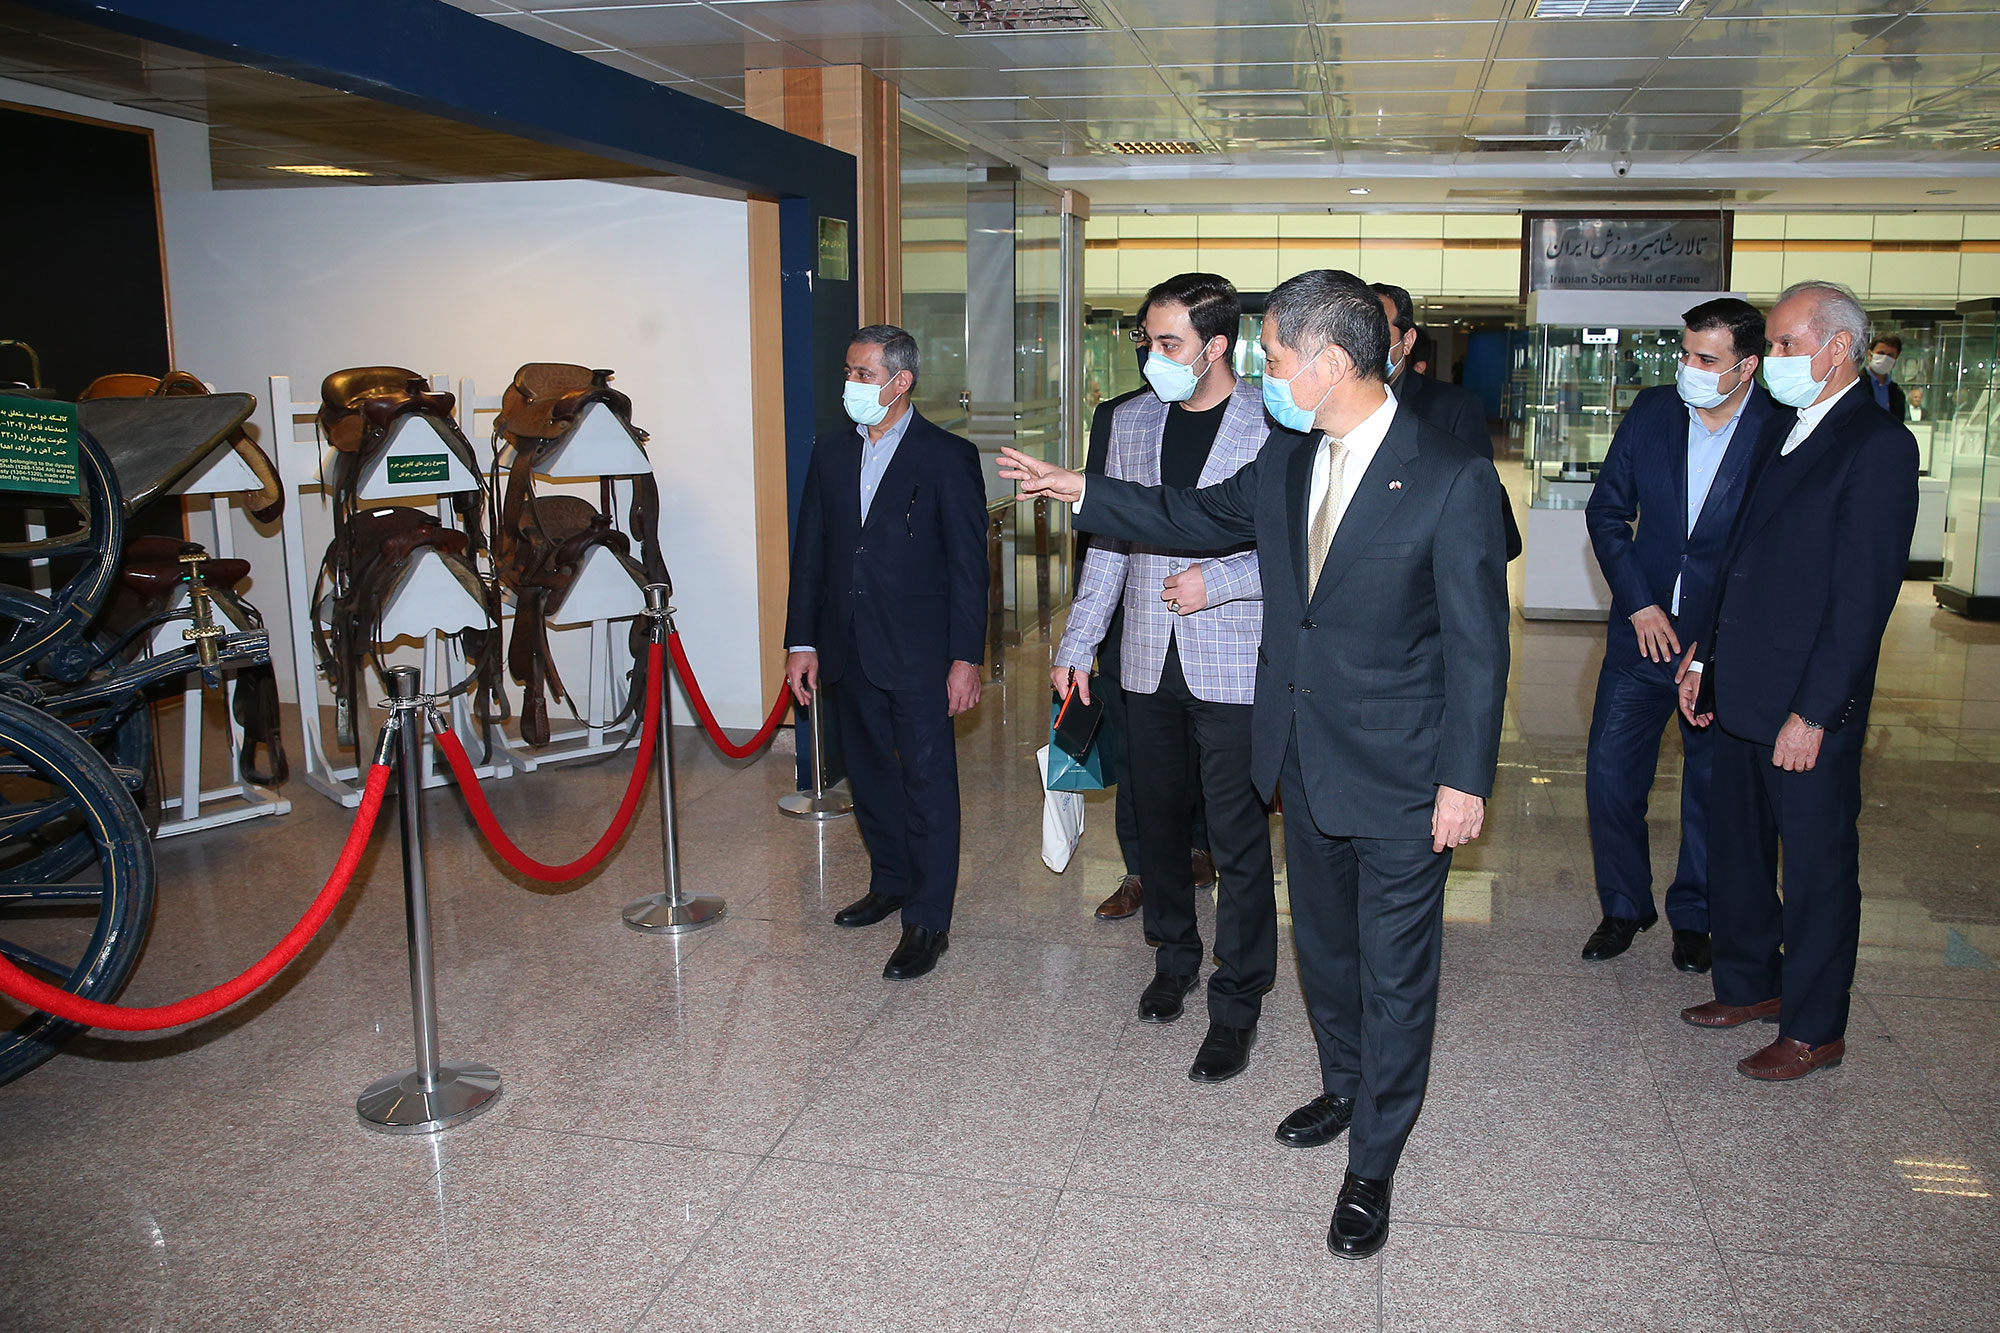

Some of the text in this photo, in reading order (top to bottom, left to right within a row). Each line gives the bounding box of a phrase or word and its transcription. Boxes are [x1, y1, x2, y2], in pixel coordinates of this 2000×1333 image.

[1546, 229, 1707, 261] تالار مشاهیر ورزش ایران
[1550, 274, 1700, 286] Iranian Sports Hall of Fame
[28, 423, 43, 431] قاجار
[18, 433, 29, 441] اول
[30, 435, 46, 444] پهلوی
[47, 437, 67, 445] حکومت
[39, 446, 51, 454] آهن
[9, 458, 37, 466] belonging
